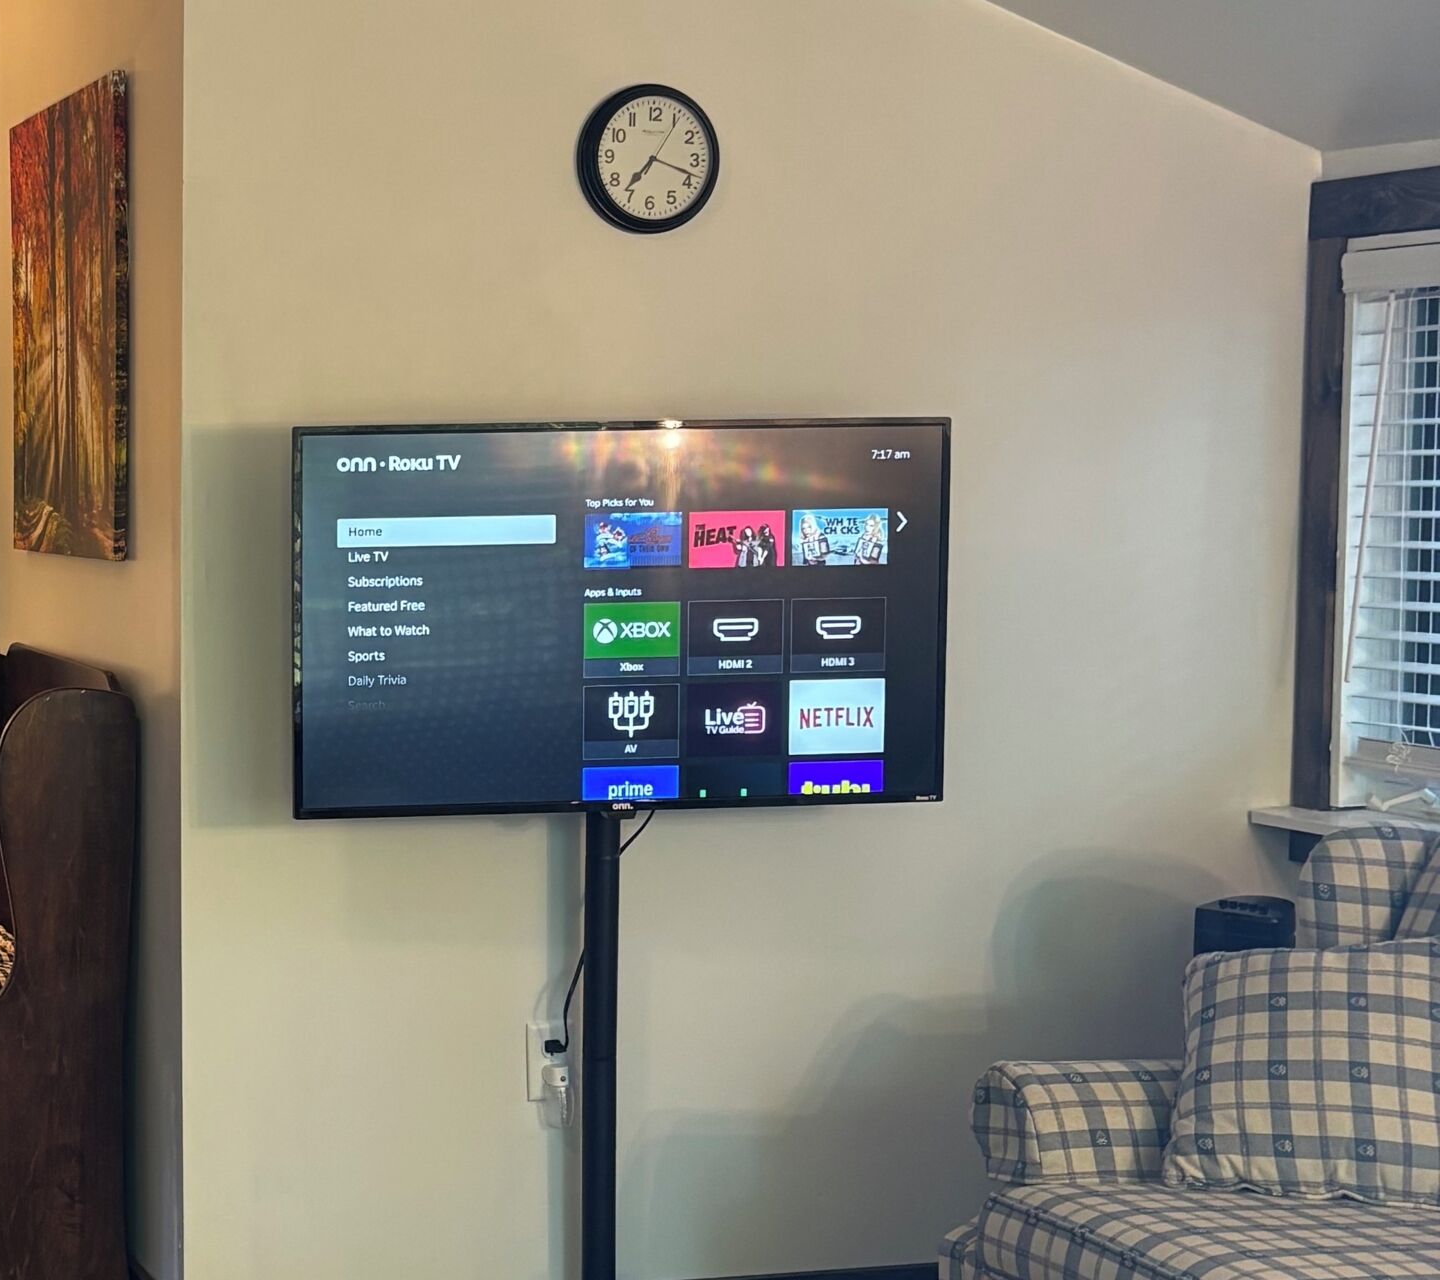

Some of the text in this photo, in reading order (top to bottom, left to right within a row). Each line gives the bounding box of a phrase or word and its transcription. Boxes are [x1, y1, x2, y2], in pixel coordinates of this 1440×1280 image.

[628, 112, 636, 128] 11
[649, 106, 663, 122] 12
[671, 113, 677, 128] 1
[612, 127, 626, 143] 10
[684, 130, 695, 145] 2
[604, 149, 615, 164] 9
[689, 153, 700, 168] 3
[609, 172, 620, 187] 8
[682, 174, 693, 189] 4
[625, 189, 635, 204] 7
[644, 195, 655, 210] 6
[666, 190, 677, 205] 5
[871, 449, 911, 460] 7:17 am
[388, 455, 433, 472] Roku
[436, 454, 462, 471] TV
[585, 498, 655, 510] Top Picks for You
[348, 526, 383, 538] Home
[693, 525, 737, 548] HEAT
[348, 551, 389, 563] Live TV
[348, 576, 424, 589] Subscriptions
[584, 588, 606, 599] Apps
[607, 587, 615, 597] &
[348, 600, 426, 612] Featured Free
[348, 624, 430, 637] What to Watch
[620, 621, 671, 639] XBOX
[348, 650, 386, 664] Sports
[718, 659, 753, 670] HDMI 2
[821, 657, 855, 668] HDMI 3
[619, 662, 644, 672] Xbox
[348, 674, 407, 688] Daily Trivia
[704, 708, 745, 725] Live
[799, 706, 874, 730] NETFLIX
[705, 725, 745, 735] TV Guide
[624, 743, 638, 754] AV
[608, 780, 654, 800] prime
